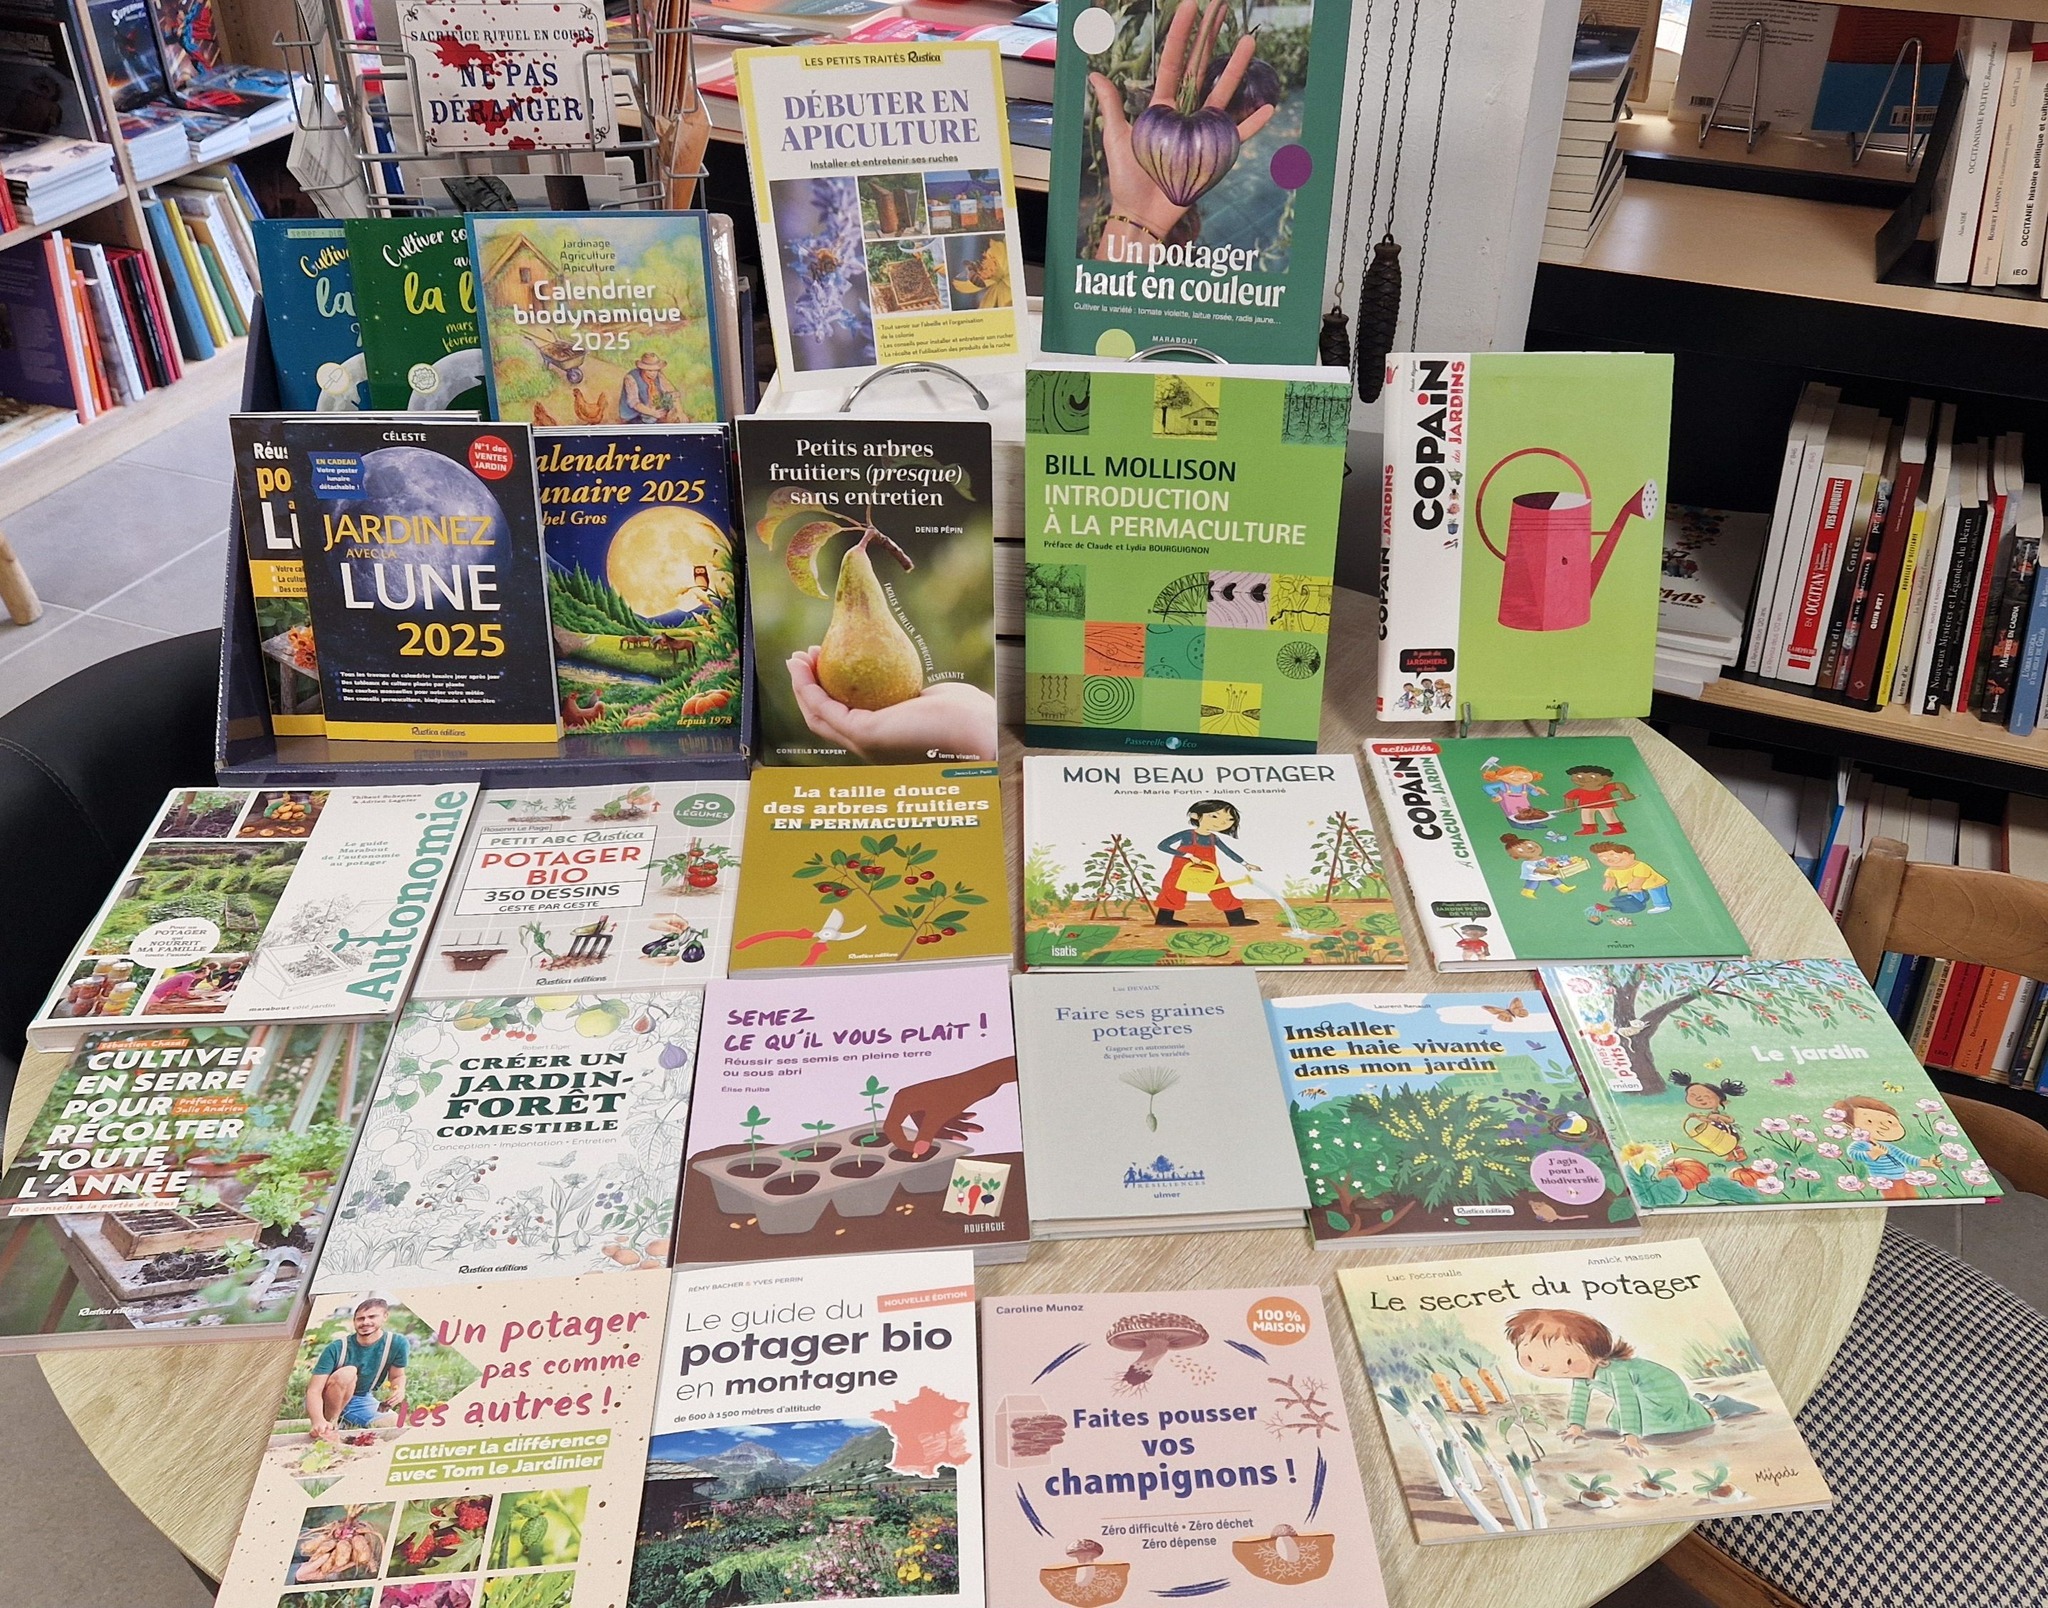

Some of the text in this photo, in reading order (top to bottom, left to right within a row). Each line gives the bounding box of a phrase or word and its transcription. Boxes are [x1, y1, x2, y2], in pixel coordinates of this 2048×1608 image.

[411, 29, 595, 41] SACRIFICE RITUEL EN COURS
[804, 50, 941, 67] LES PETITS TRAITÉS Rustica
[461, 63, 558, 88] NE PAS
[429, 94, 583, 124] DÉRANGER
[783, 89, 970, 120] DÉBUTER EN
[781, 118, 980, 151] APICULTURE
[1968, 81, 1991, 175] OCCITANISME POLITIC
[810, 154, 959, 170] Installer et entretenir ses ruches
[2020, 133, 2045, 247] OCCITANIE histoire politique
[563, 239, 611, 251] Jardinage
[560, 250, 615, 262] Agriculture
[1107, 234, 1259, 277] Un potager
[563, 262, 615, 273] Apiculture
[2012, 268, 2028, 277] IEO
[534, 280, 657, 301] Calendrier
[1074, 265, 1286, 307] haut en couleur
[513, 304, 681, 329] biodynamique
[572, 332, 631, 351] 2025
[1152, 335, 1198, 345] MARABOUT
[1449, 361, 1465, 444] JARDINS
[382, 430, 427, 442] CÉLESTE
[474, 452, 508, 463] VENTES
[795, 439, 934, 457] Petits arbres
[474, 461, 507, 472] JARDIN
[769, 463, 963, 485] fruitiers (presque)
[1045, 454, 1236, 482] BILL MOLLISON
[790, 489, 944, 506] sans entretien
[1044, 484, 1229, 512] INTRODUCTION
[1824, 479, 1845, 530] YVES ROUQUETTE
[323, 514, 495, 552] JARDINEZ
[940, 525, 963, 534] PÉPIN
[1043, 507, 1306, 545] À LA PERMACULTURE
[1959, 518, 1972, 546] Béarn
[1044, 541, 1072, 549] Préface
[1086, 542, 1112, 550] Claude
[1126, 543, 1146, 552] Lydia
[1149, 544, 1210, 555] BOURGUIGNON
[1846, 536, 1862, 573] Contes
[1959, 547, 1965, 557] du
[339, 564, 502, 611] LUNE
[1952, 562, 1963, 598] Légendes
[1804, 572, 1826, 628] EN OCCITAN
[1949, 599, 1955, 610] et
[396, 622, 505, 657] 2025
[1823, 620, 1843, 676] Arnaudin
[1931, 651, 1944, 689] Nouveaux
[677, 716, 732, 727] depuis 1978
[1381, 744, 1434, 753] activités
[1063, 765, 1336, 784] MON BEAU POTAGER
[793, 785, 961, 798] La taille douce
[676, 808, 730, 819] LÉGUMES
[691, 800, 721, 810] 50
[490, 830, 644, 846] PETIT ABC Rustica
[1441, 809, 1469, 858] CHACUN
[481, 846, 642, 869] POTAGER
[526, 868, 589, 885] BIO
[345, 790, 468, 1003] Autonomie
[1051, 945, 1077, 957] isatis
[727, 1007, 815, 1027] SEMEZ
[1055, 1003, 1225, 1022] Faire ses graines
[1092, 1022, 1193, 1042] potagères
[1284, 1020, 1396, 1041] Installer
[88, 1047, 267, 1071] CULTIVER
[724, 1050, 932, 1066] Réussir ses semis en pleine terre
[1751, 1043, 1870, 1065] Le jardin
[73, 1070, 251, 1095] EN SERRE
[443, 1089, 626, 1120] FORÊT
[436, 1119, 619, 1138] COMESTIBLE
[1548, 1157, 1578, 1167] J'agis
[18, 1165, 192, 1199] L'ANNÉE
[1540, 1175, 1600, 1184] biodiversité
[1153, 1191, 1181, 1199] ulmer
[964, 1222, 1005, 1234] ROUERGUE
[458, 1264, 528, 1274] Rustica éditions
[1587, 1253, 1662, 1266] Annick Masson
[1386, 1269, 1462, 1282] Luc Foccroulle
[1370, 1272, 1702, 1311] Le secret du potager
[996, 1304, 1084, 1315] Caroline Munoz
[1256, 1309, 1301, 1321] 100 %
[1253, 1321, 1306, 1334] MAISON
[680, 1321, 953, 1376] potager bio
[395, 1433, 608, 1461] Cultiver la différence
[1045, 1462, 1278, 1501] champignons
[1754, 1466, 1800, 1487] Mijade
